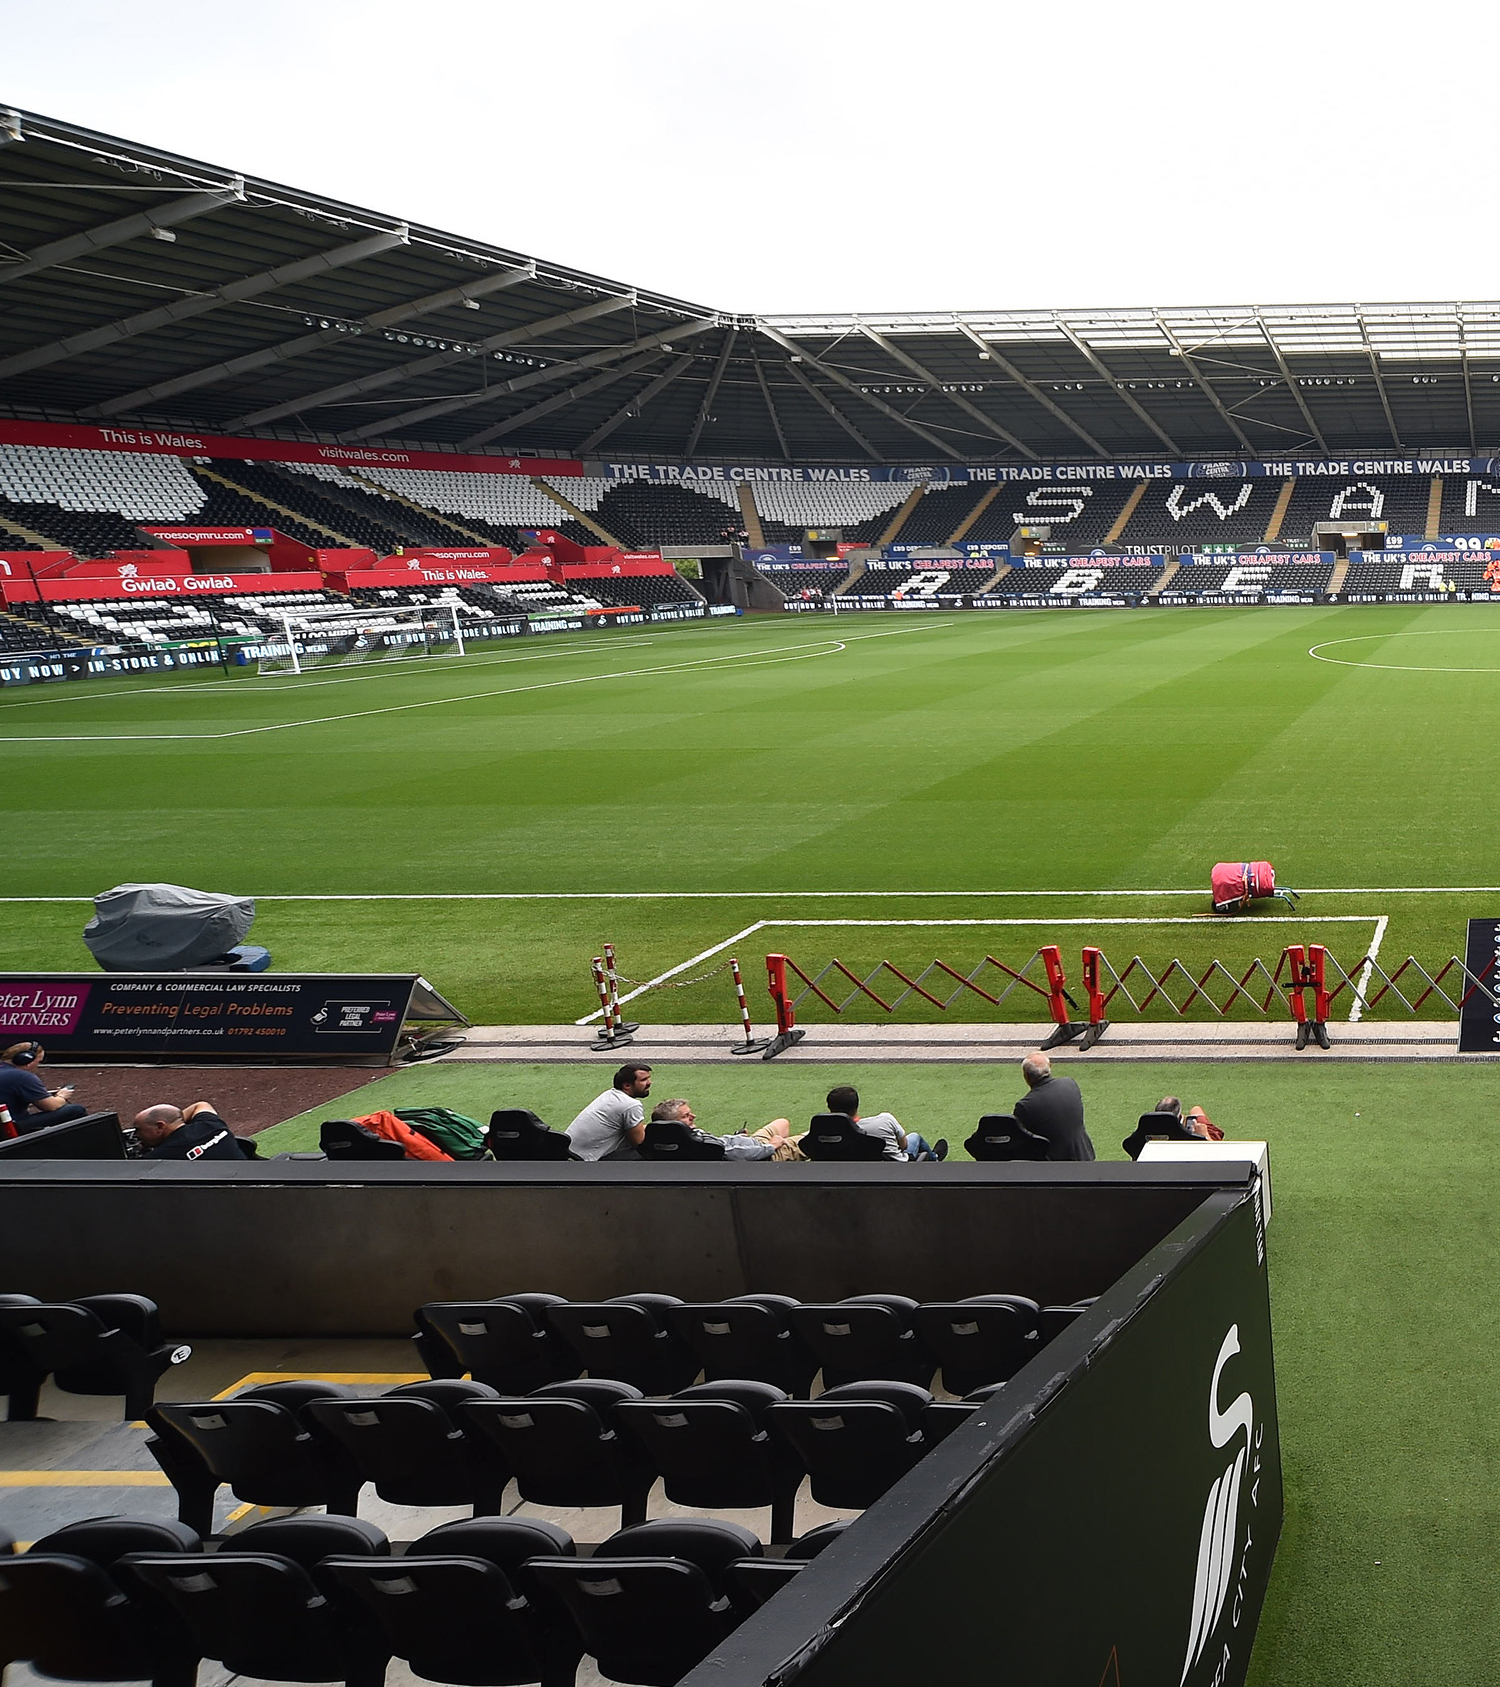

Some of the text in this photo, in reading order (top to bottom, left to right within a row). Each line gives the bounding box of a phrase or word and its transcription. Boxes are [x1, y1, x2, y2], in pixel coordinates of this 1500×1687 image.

[99, 428, 208, 449] This is Wales.
[318, 446, 410, 463] visitwales.com
[610, 464, 871, 482] THE TRADE CENTRE WALES
[967, 464, 1172, 481] THE TRADE CENTRE WALES
[1263, 459, 1471, 476] THE TRADE CENTRE WALES
[153, 532, 245, 542] croesocymru.com
[1386, 536, 1403, 545] £99
[1125, 545, 1197, 555] TRUSTPILOT
[1362, 551, 1491, 563] THE UK'S CHEAPEST CARS
[421, 569, 489, 581] This is Wales.
[122, 576, 238, 592] Gwlad, Gwlad.
[528, 619, 582, 632] TRAINING WEAR
[383, 634, 402, 645] BUY
[491, 624, 522, 635] ONLINE
[241, 643, 329, 659] TRAINING WEAR
[0, 667, 21, 682] UY
[29, 663, 64, 679] NOW
[88, 654, 158, 673] IN-STORE
[164, 653, 174, 666] &
[110, 983, 154, 992] COMPANY
[165, 984, 224, 992] COMMERCIAL
[226, 984, 246, 992] LAW
[247, 984, 301, 992] SPECIALISTS
[30, 990, 78, 1013] Lynn
[102, 1003, 293, 1018] Preventing Legal Problems
[0, 1013, 71, 1026] ARTNERS
[93, 1027, 286, 1036] www.peterlynnandpartners.co.uk 01792 450010
[1234, 1422, 1265, 1629] CITY AFC
